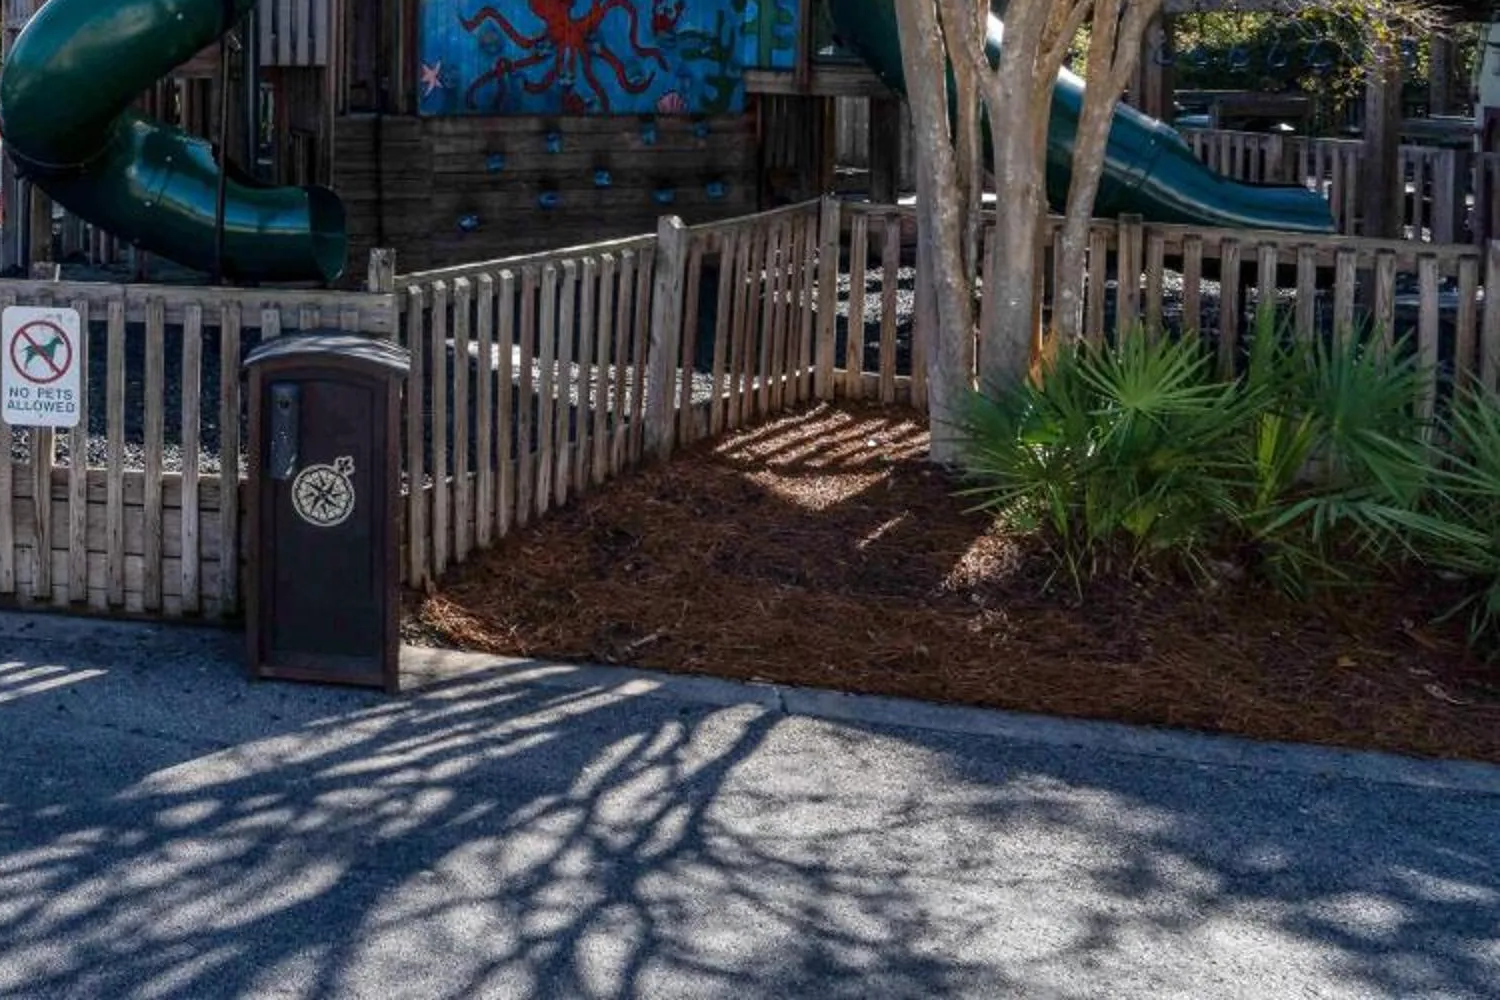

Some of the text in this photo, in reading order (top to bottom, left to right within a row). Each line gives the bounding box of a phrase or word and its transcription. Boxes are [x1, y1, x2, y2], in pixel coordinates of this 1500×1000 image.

[9, 387, 73, 400] NO PETS
[7, 400, 75, 413] ALLOWED
